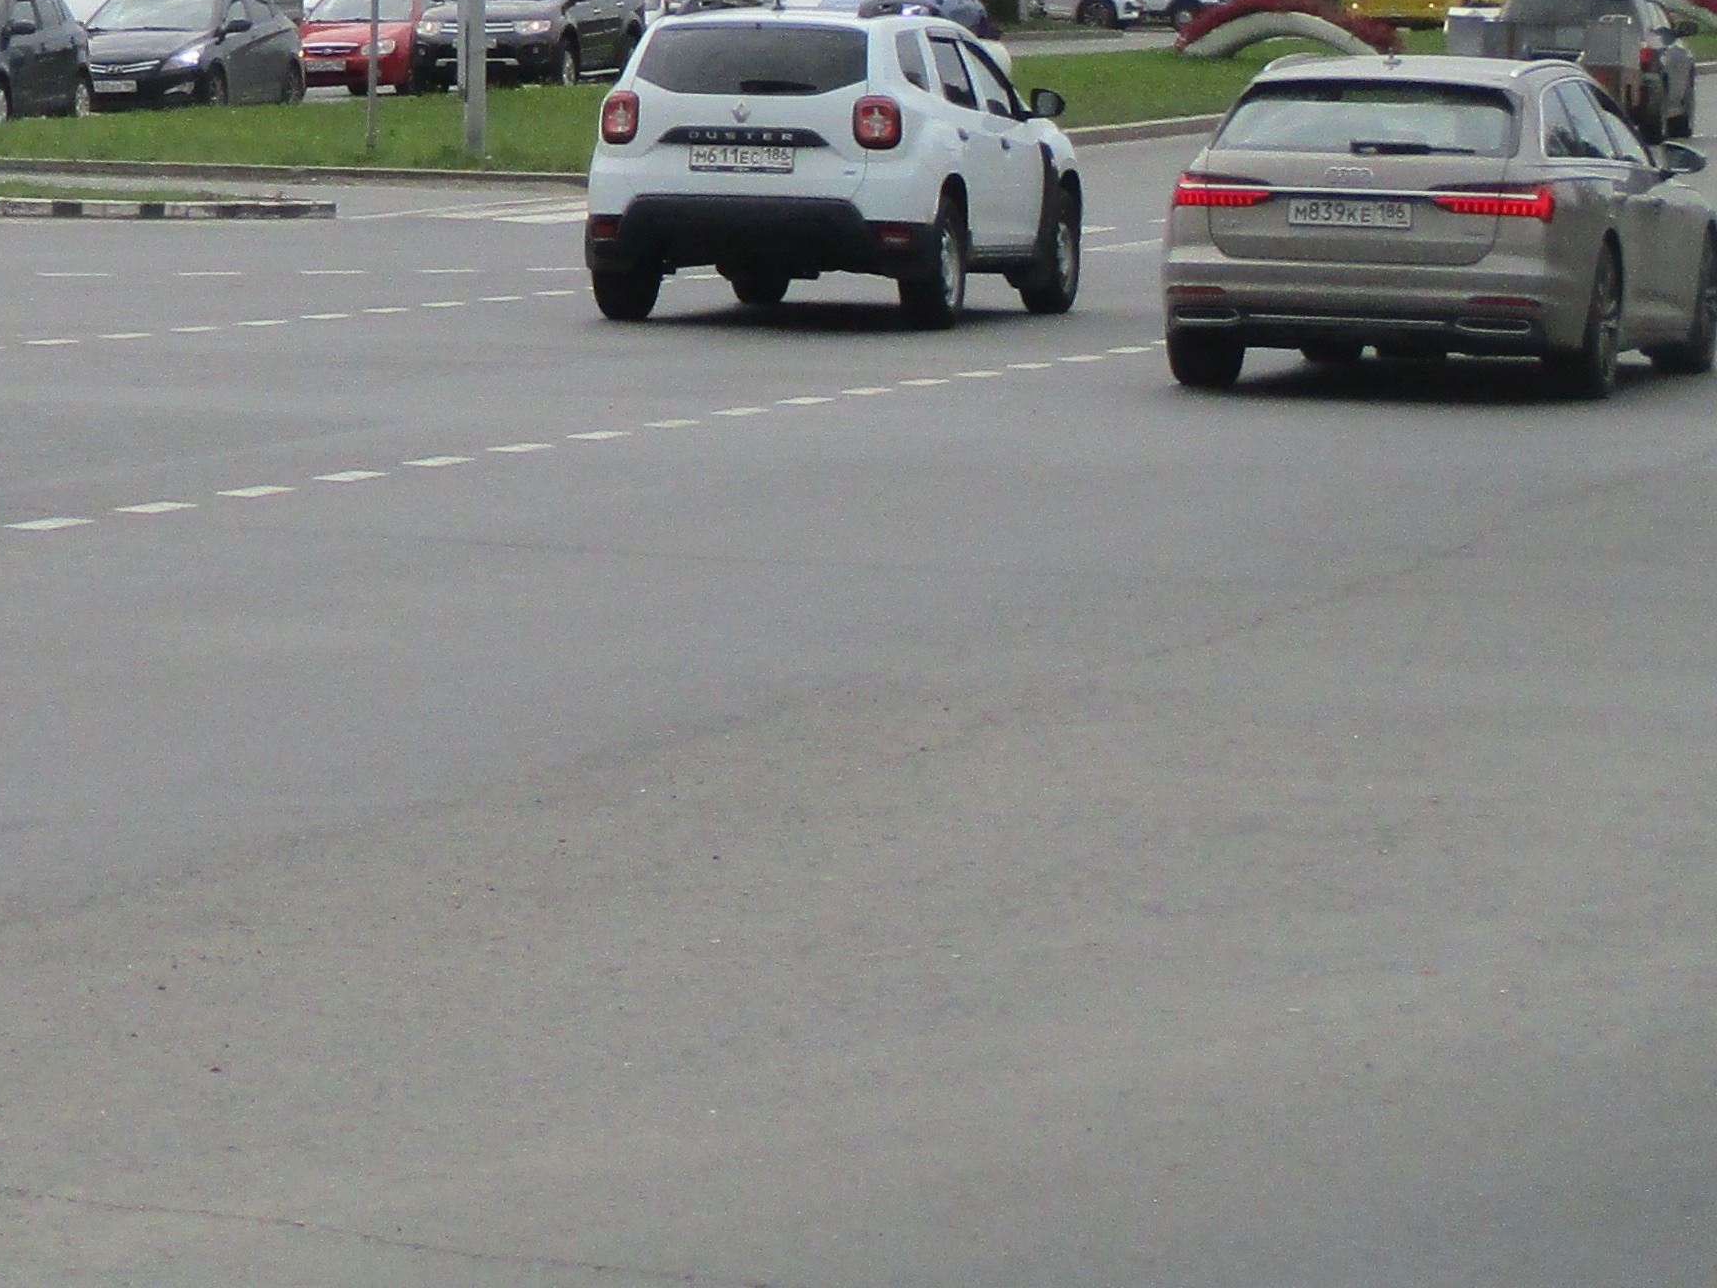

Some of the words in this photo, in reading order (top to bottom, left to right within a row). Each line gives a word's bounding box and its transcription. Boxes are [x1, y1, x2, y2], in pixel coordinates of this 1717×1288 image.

[688, 132, 794, 142] DUSTER
[765, 147, 791, 162] 186
[1378, 204, 1405, 219] 186
